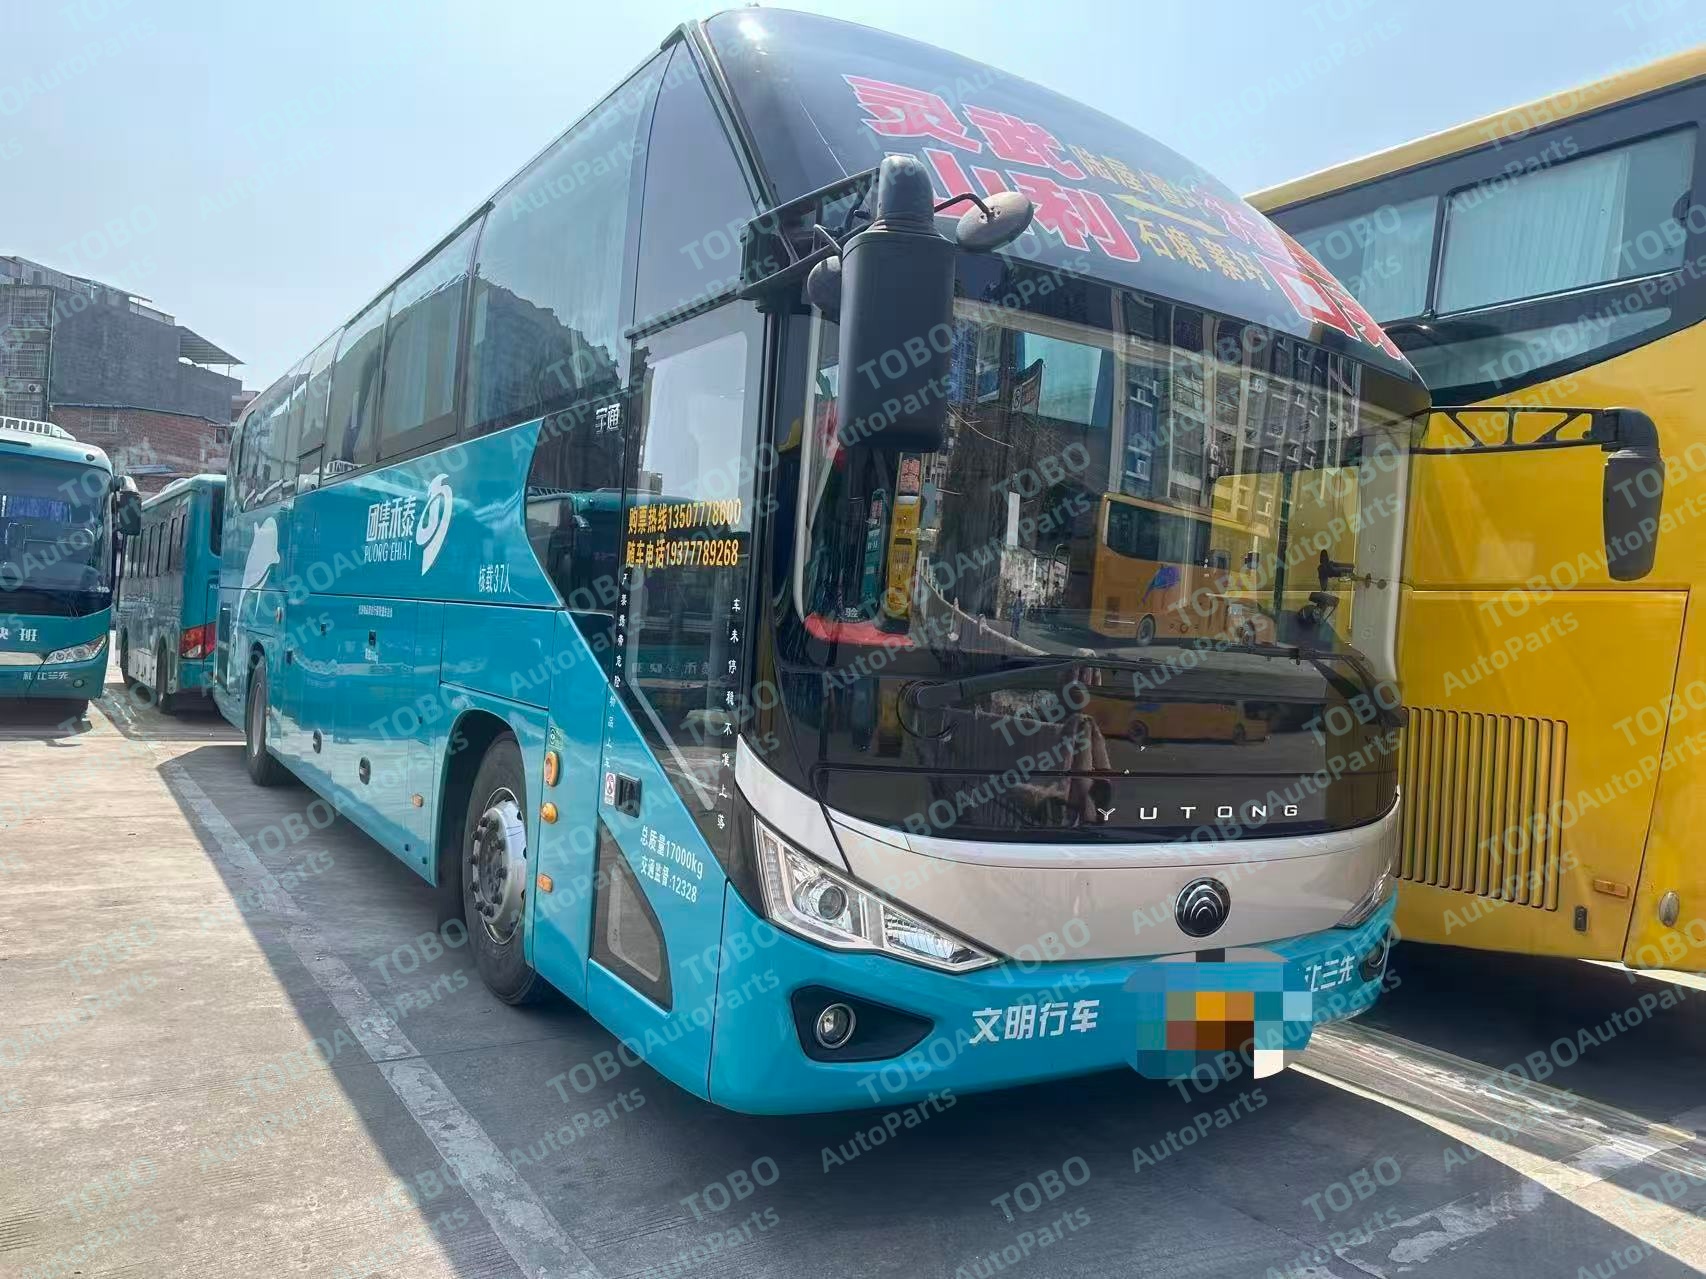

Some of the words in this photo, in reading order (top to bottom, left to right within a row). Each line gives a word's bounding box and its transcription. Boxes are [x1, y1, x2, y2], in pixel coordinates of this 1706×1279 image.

[595, 403, 621, 433] 宇通
[1097, 804, 1299, 821] YUTONG
[640, 825, 704, 880] 总质量17000kg
[1297, 955, 1356, 993] 让三先
[968, 999, 1101, 1046] 文明行车
